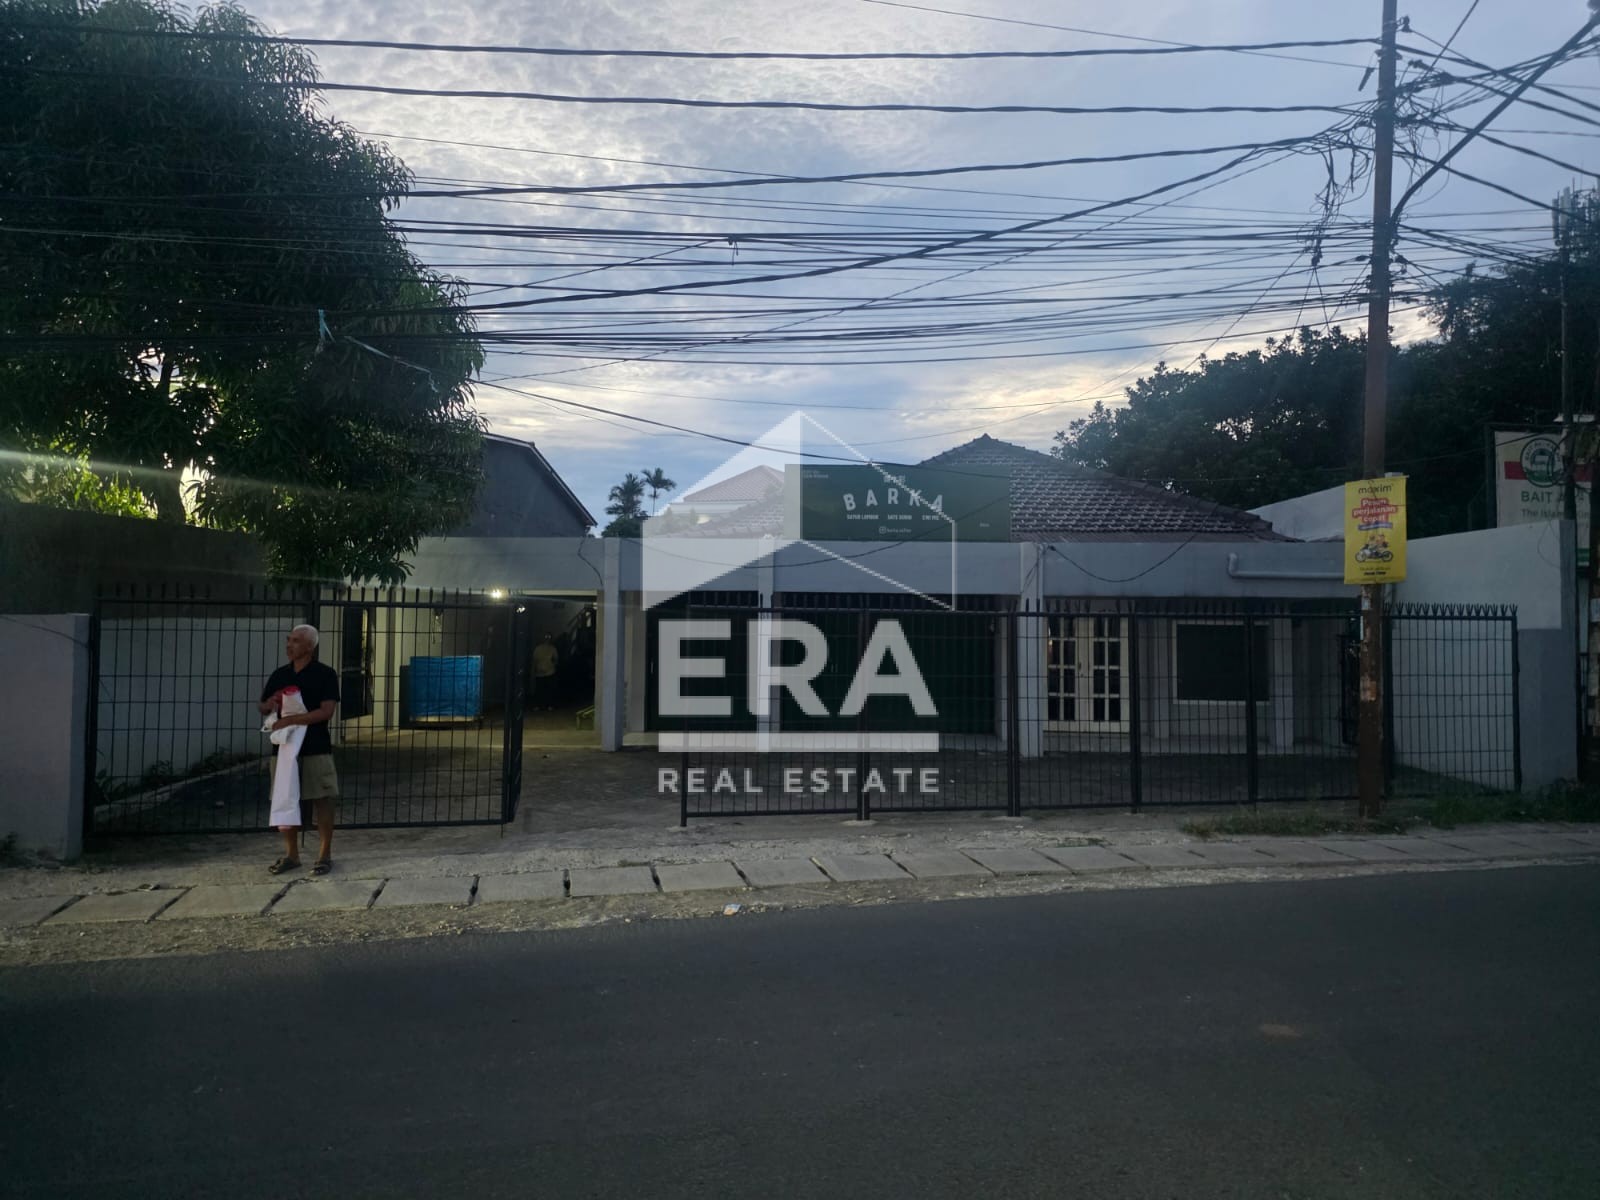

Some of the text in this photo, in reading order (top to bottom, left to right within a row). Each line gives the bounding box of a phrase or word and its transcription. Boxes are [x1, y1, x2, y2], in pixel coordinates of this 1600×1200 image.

[1358, 484, 1392, 495] maxim
[842, 487, 943, 511] BARKA
[1521, 490, 1553, 504] BAIT
